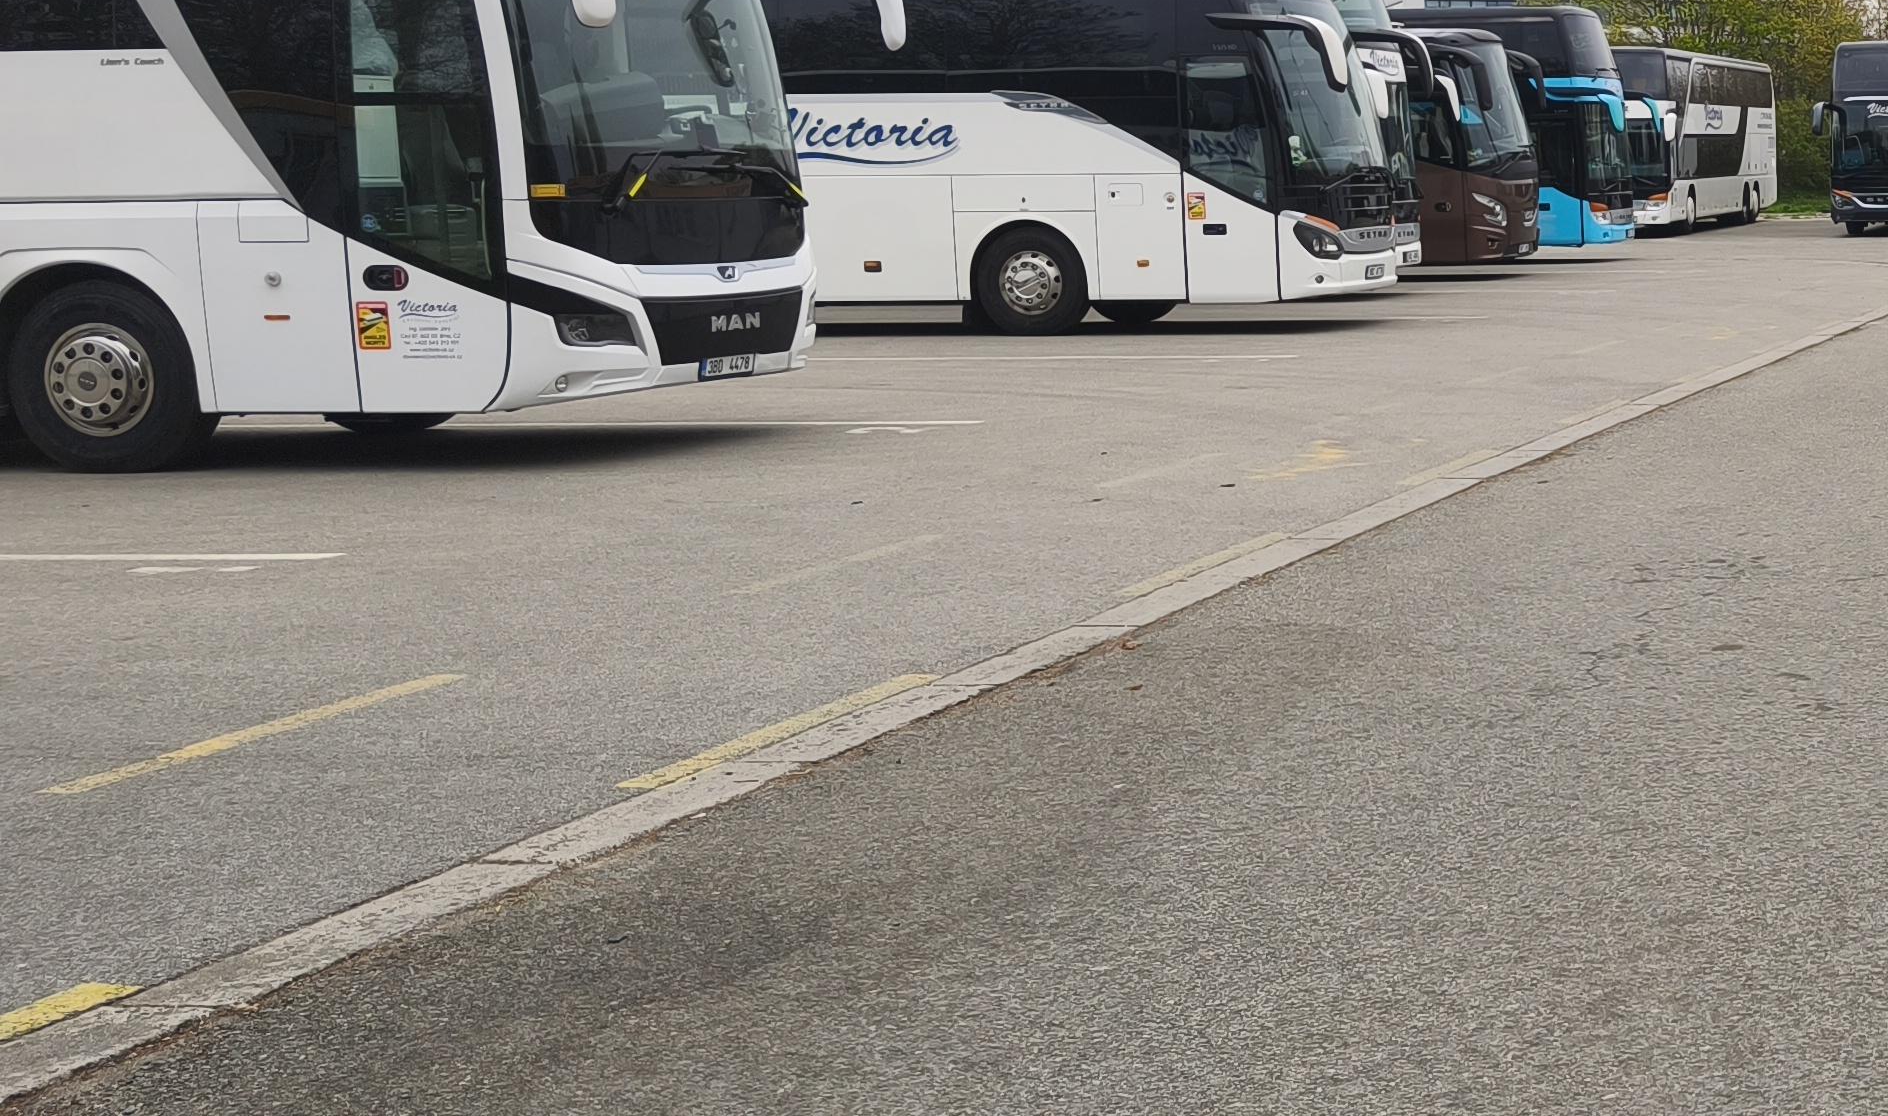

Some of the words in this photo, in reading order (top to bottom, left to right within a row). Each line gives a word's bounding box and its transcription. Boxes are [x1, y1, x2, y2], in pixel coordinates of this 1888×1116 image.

[788, 107, 958, 148] Victoria
[397, 299, 458, 312] Victoria
[711, 312, 761, 333] MAN
[729, 355, 751, 371] 4478
